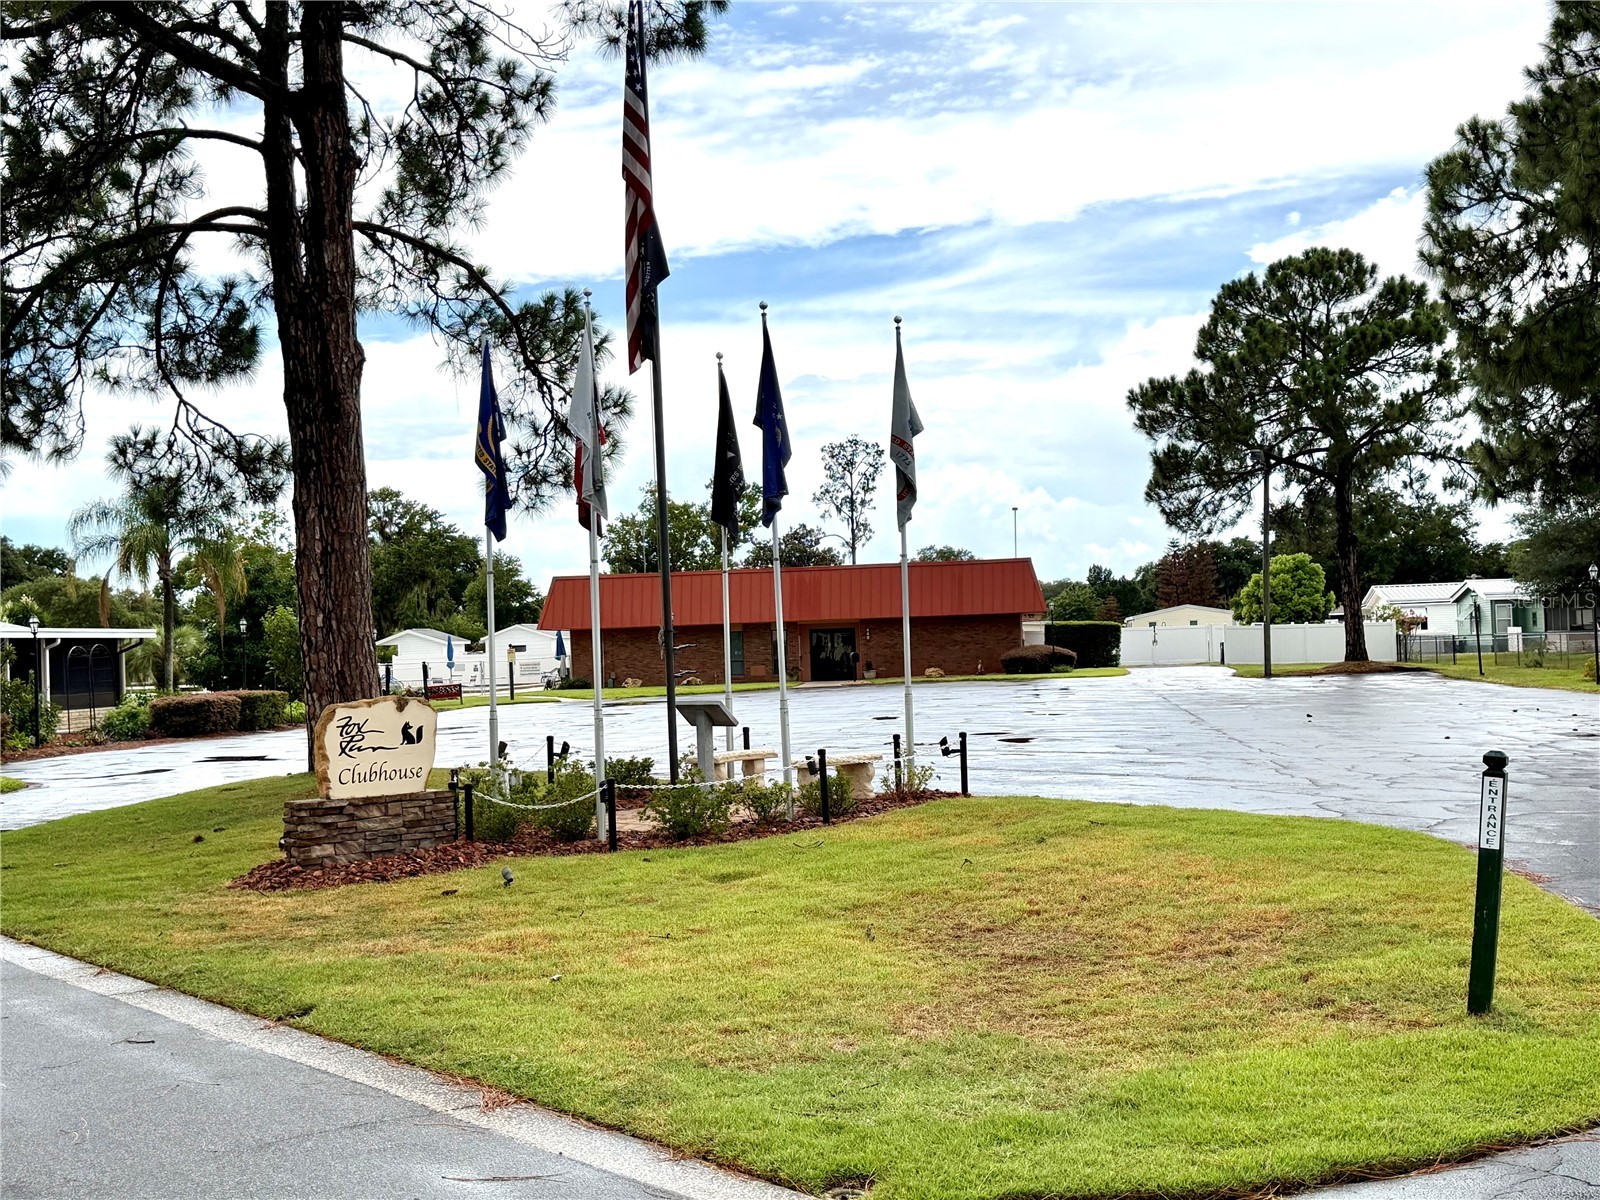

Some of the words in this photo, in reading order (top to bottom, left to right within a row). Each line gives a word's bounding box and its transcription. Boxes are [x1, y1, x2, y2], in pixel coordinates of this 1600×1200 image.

[896, 450, 912, 466] 1775
[336, 715, 385, 737] Fox
[338, 733, 399, 759] Run
[338, 760, 423, 785] Clubhouse
[1485, 780, 1499, 846] ENTRANCE
